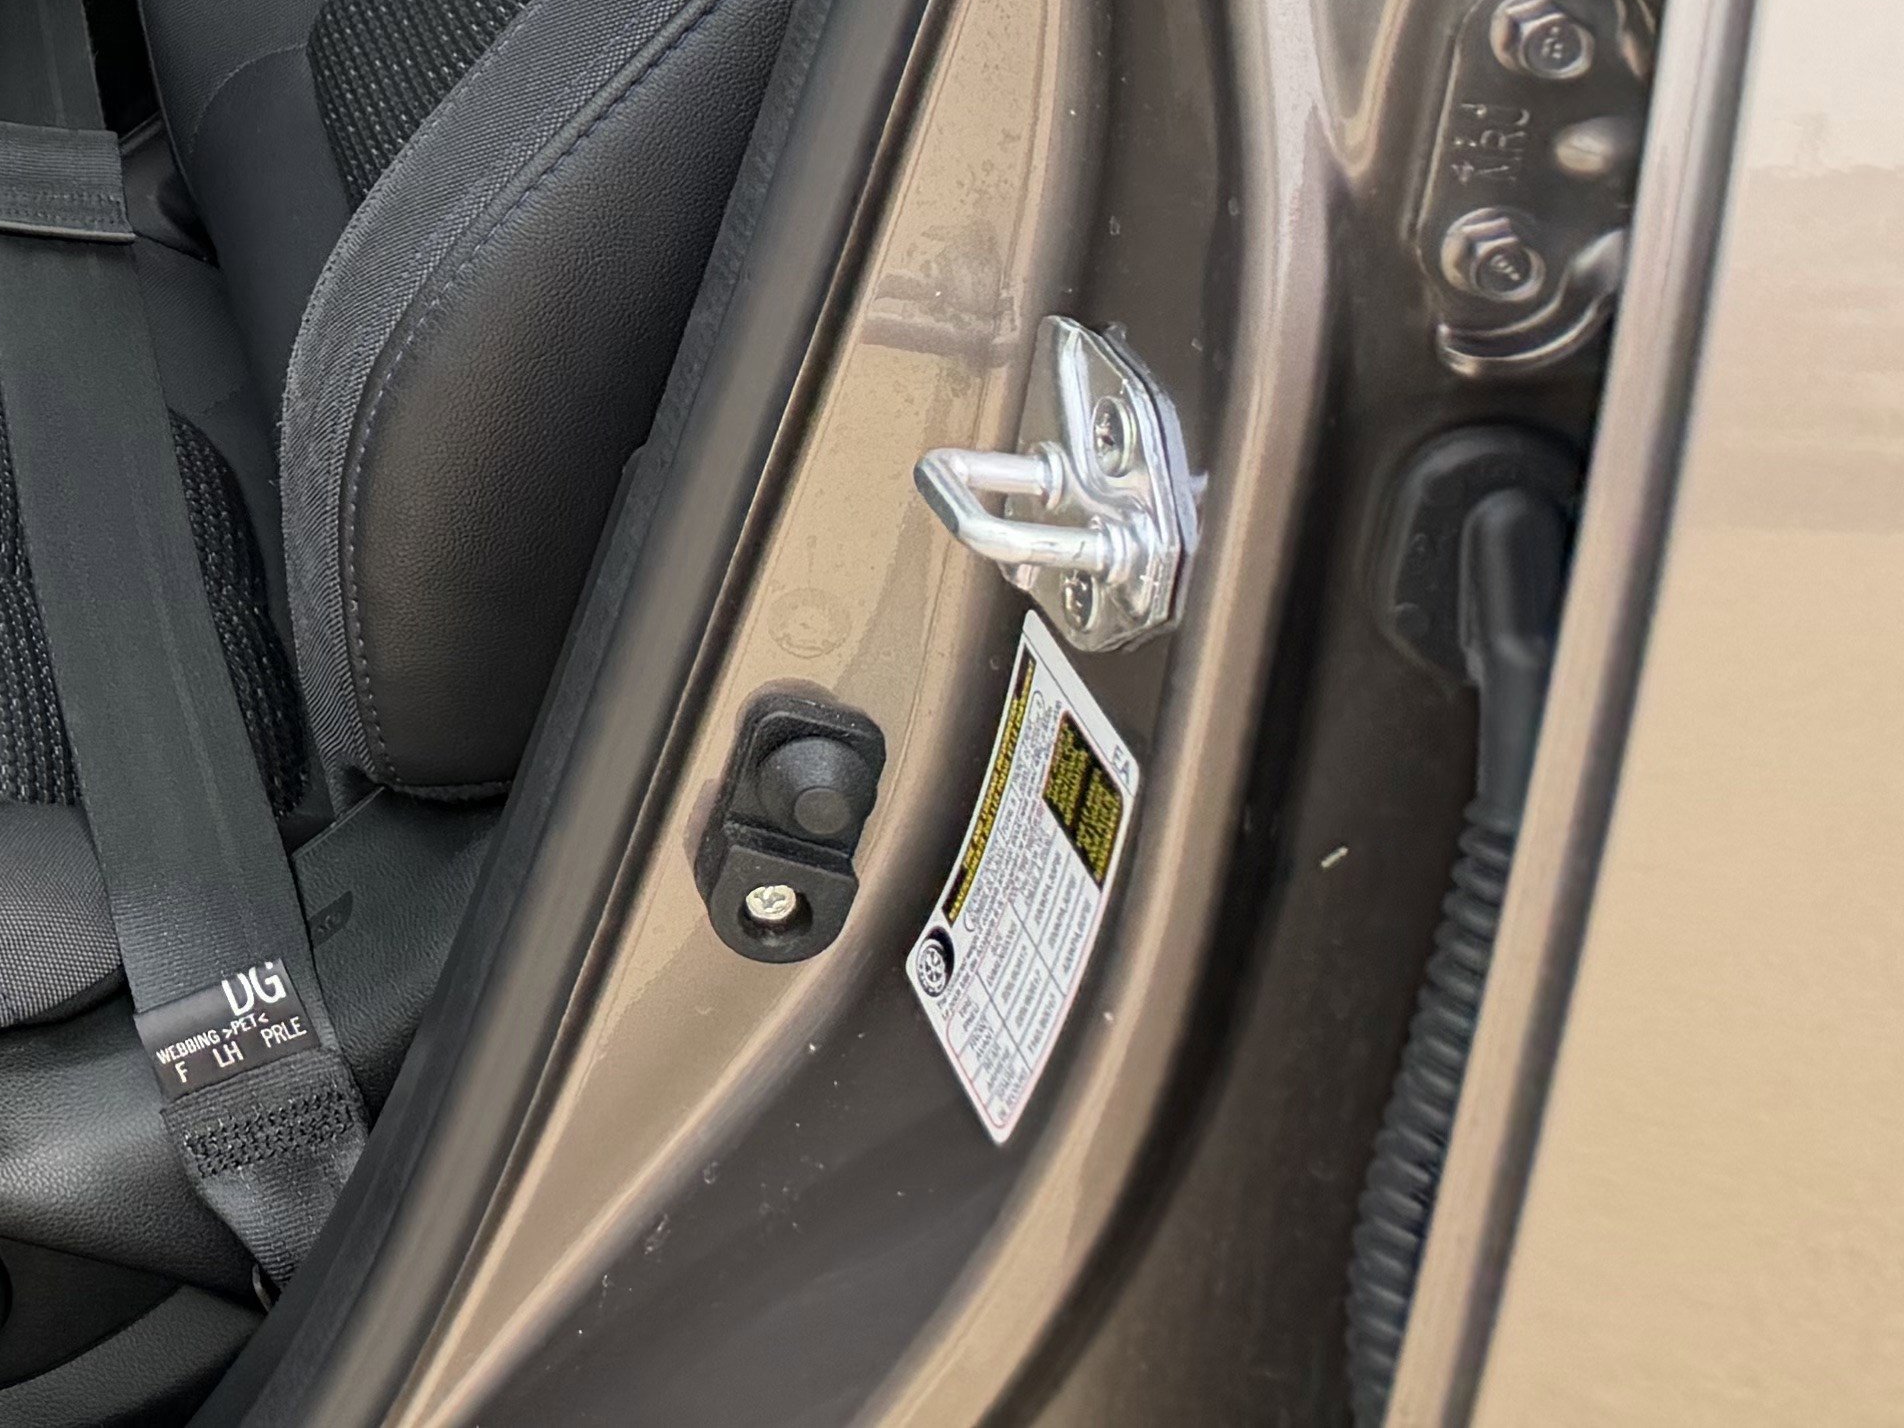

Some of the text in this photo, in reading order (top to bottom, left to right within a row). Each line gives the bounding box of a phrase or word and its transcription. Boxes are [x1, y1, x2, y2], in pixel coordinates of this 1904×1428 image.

[155, 1012, 270, 1065] WEBBING >PET<
[174, 1015, 308, 1084] F LH PRLE
